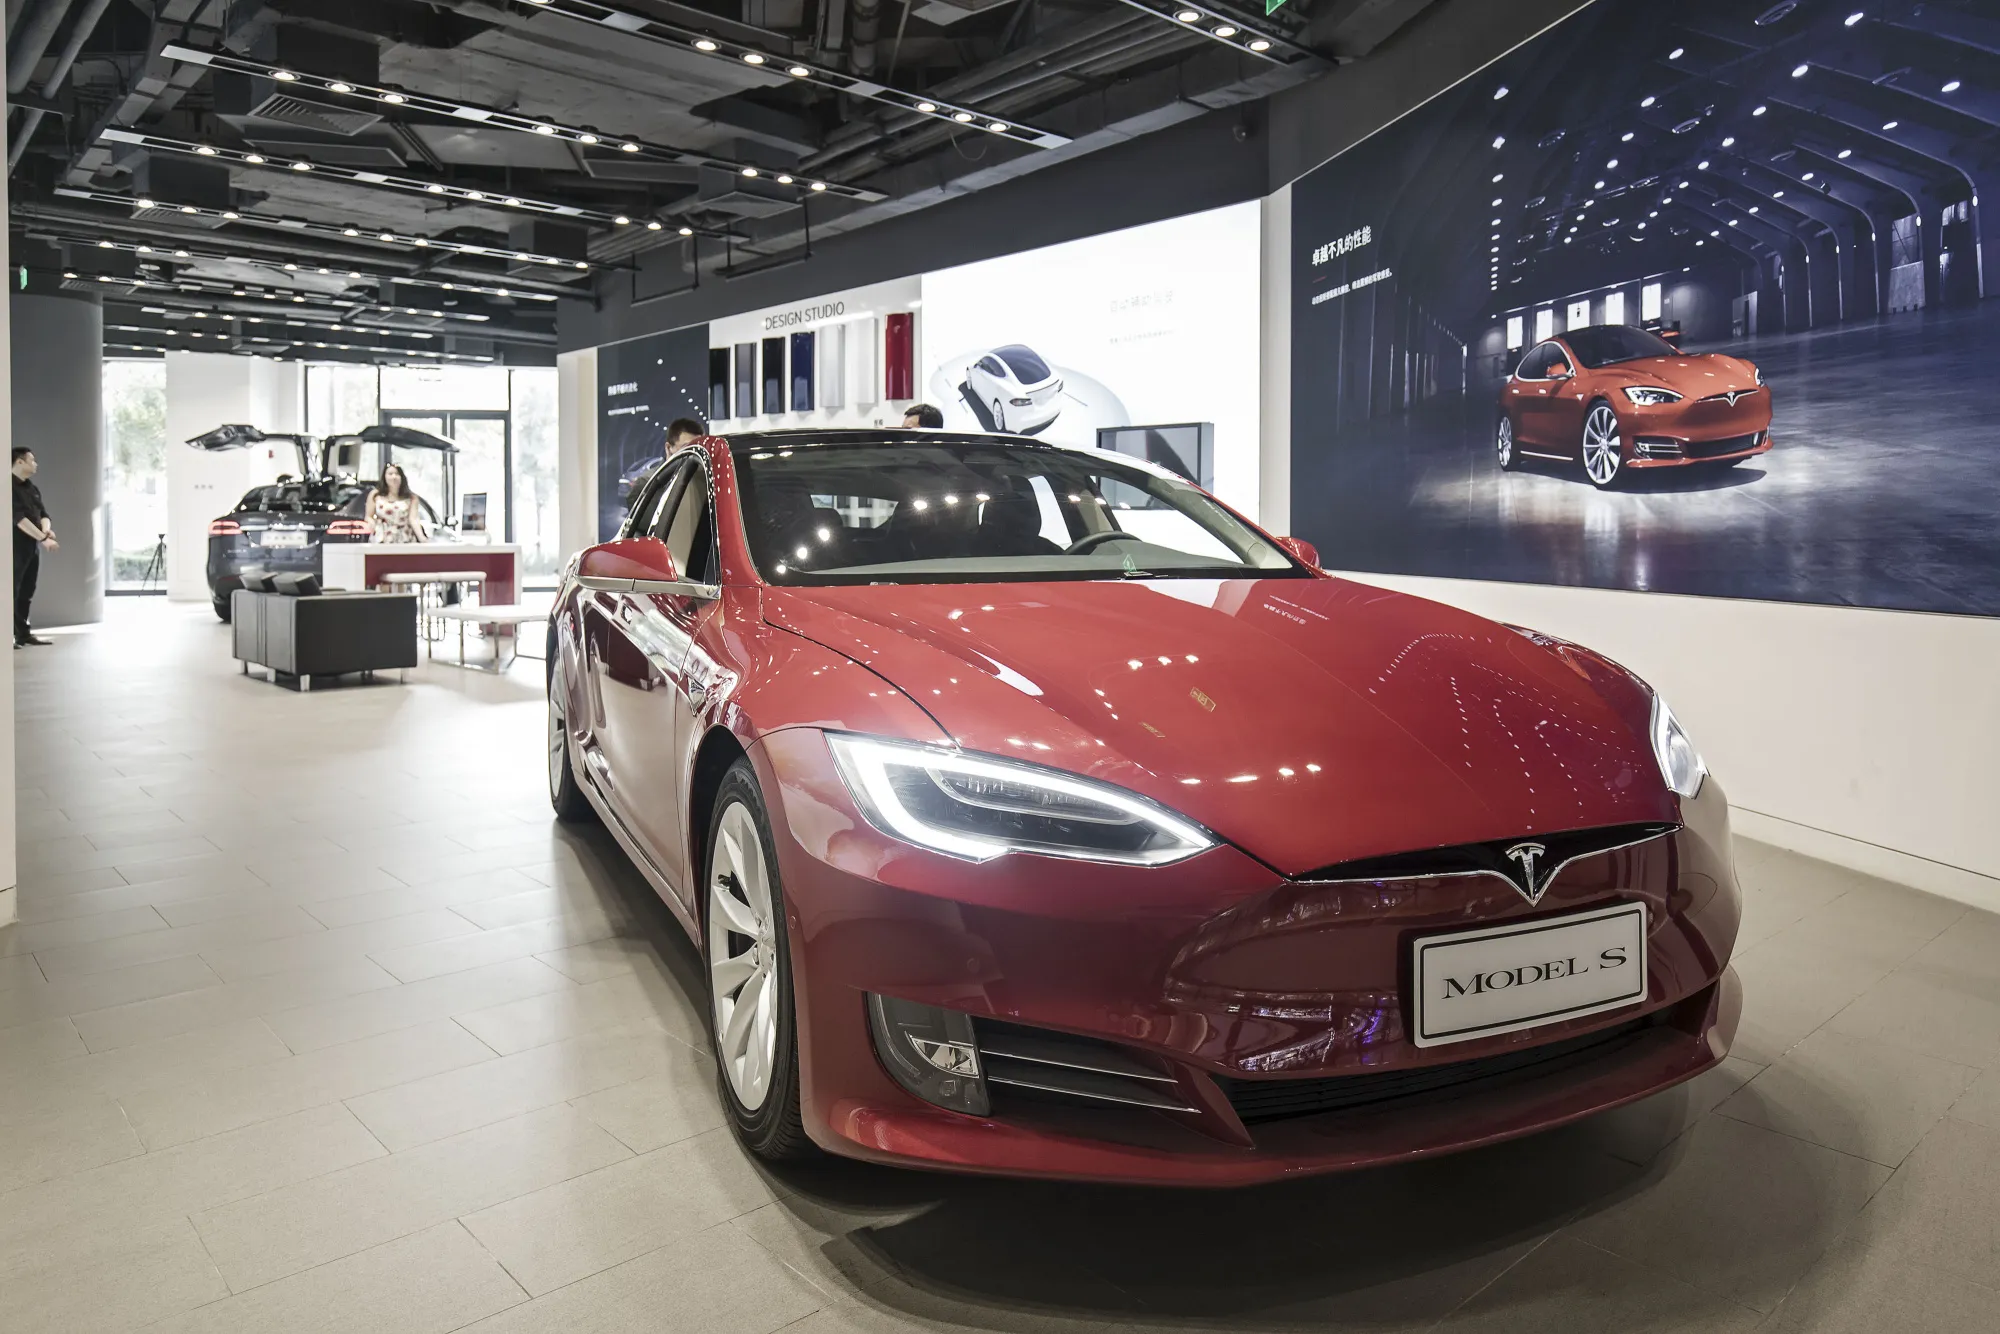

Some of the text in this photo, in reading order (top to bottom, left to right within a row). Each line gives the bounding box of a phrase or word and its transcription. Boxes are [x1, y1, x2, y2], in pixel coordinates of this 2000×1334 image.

[1312, 225, 1371, 266] 卓越不凡的性能
[765, 301, 845, 331] DESIGN STUDIO
[1441, 946, 1627, 999] MODEL S
